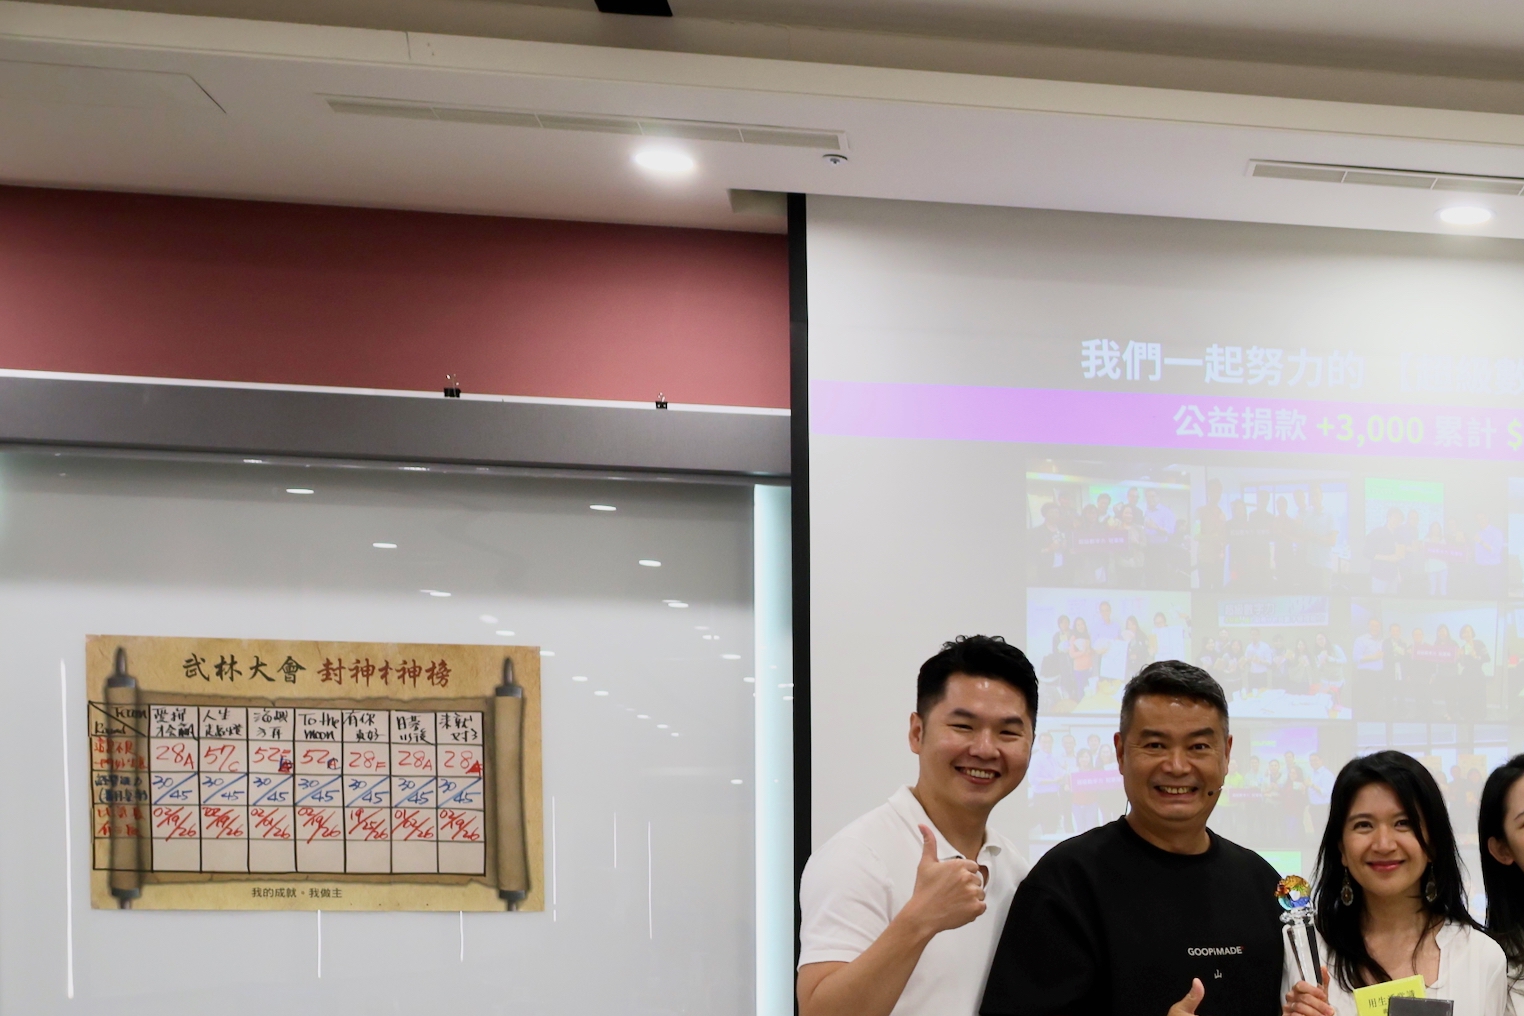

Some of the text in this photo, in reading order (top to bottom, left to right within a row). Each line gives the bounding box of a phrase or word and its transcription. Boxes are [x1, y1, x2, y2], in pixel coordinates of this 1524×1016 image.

[1081, 340, 1364, 390] 我們一起努力的
[1172, 404, 1307, 441] 公益捐款
[1316, 412, 1424, 446] +3,000
[1434, 416, 1496, 449] 累計
[182, 653, 306, 684] 武林大會
[298, 712, 340, 729] To the
